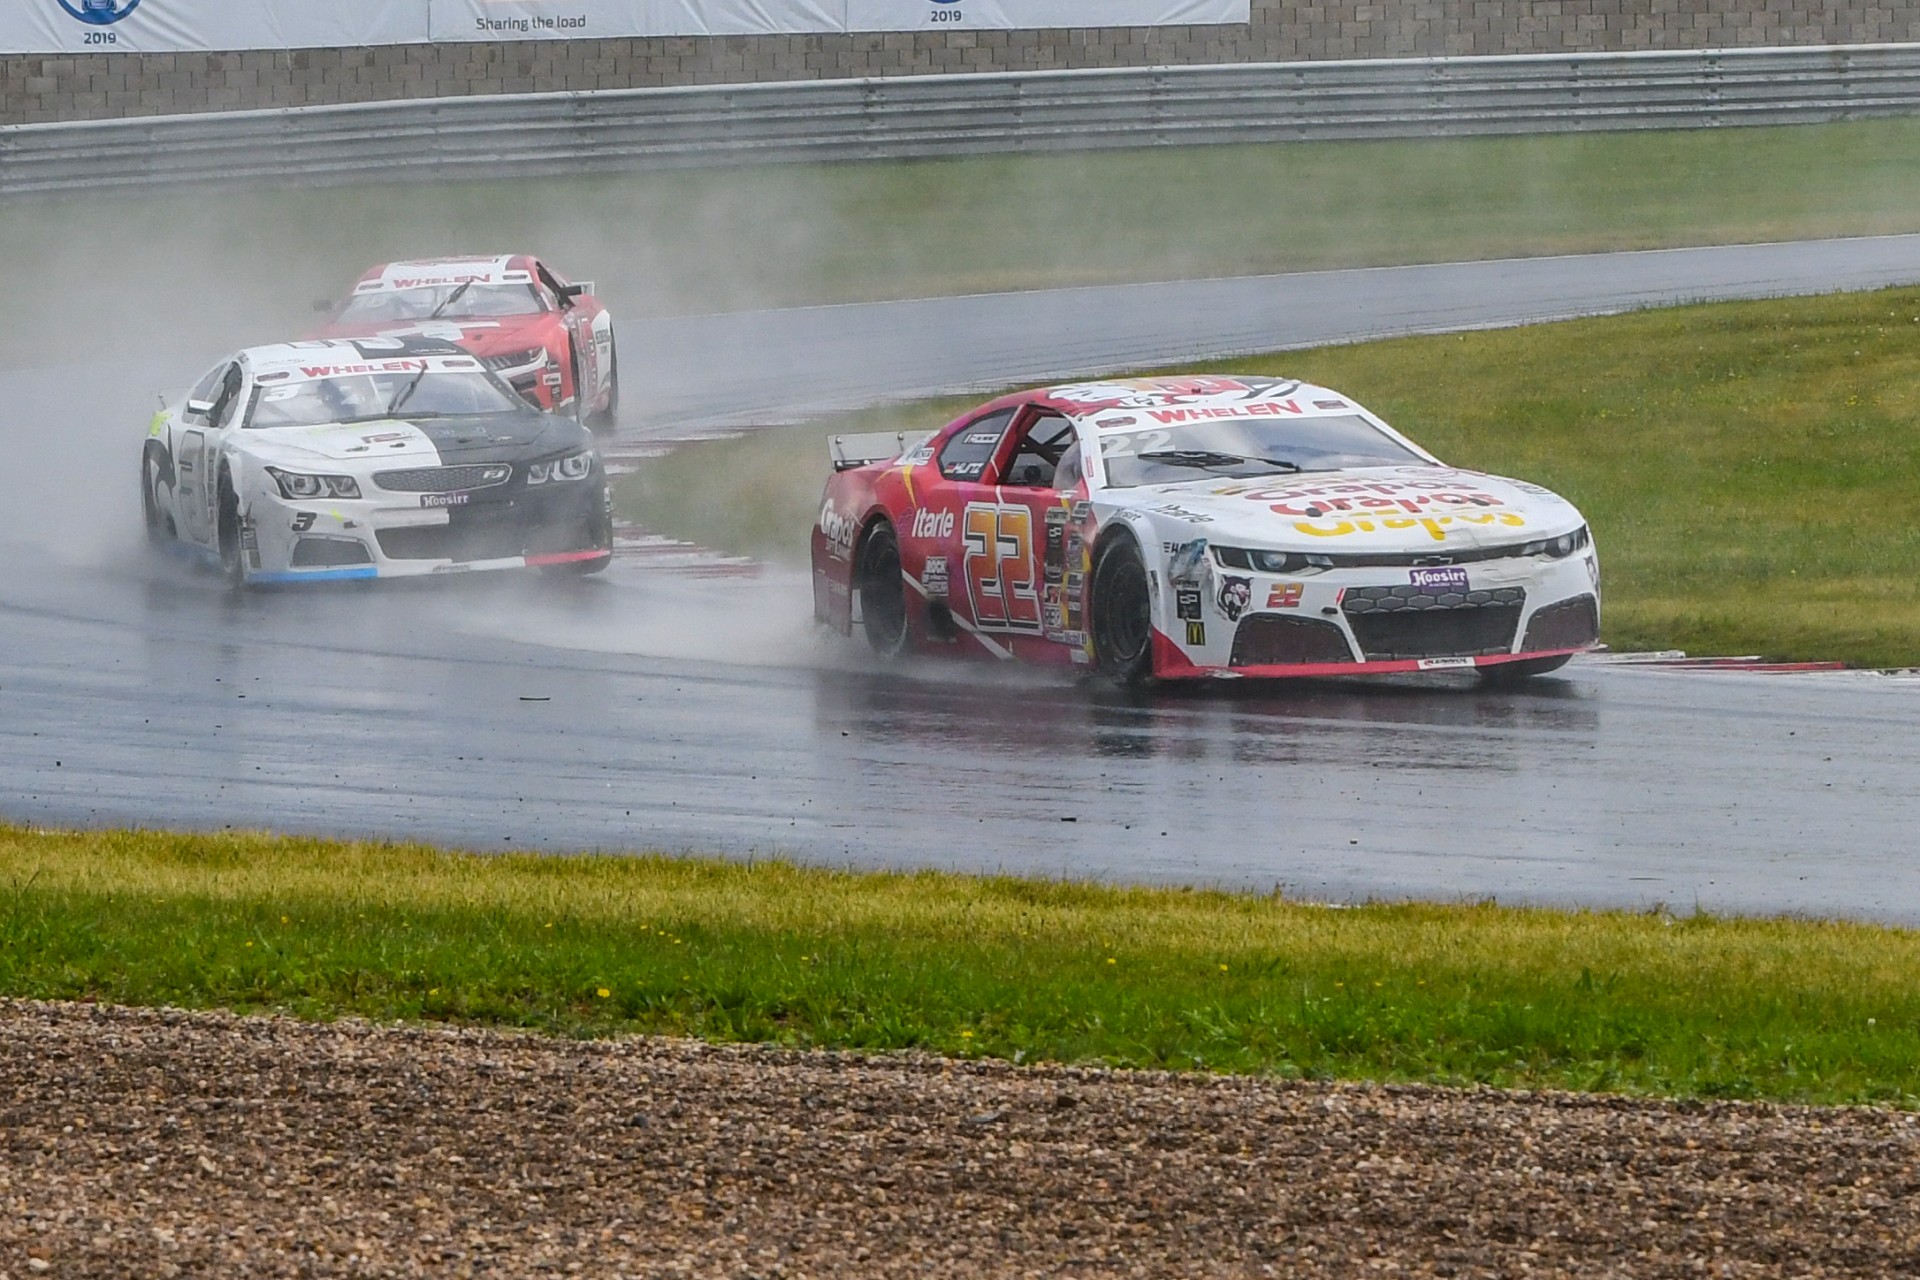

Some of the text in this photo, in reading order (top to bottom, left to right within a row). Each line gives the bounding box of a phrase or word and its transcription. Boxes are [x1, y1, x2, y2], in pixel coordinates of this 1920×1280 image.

[476, 14, 586, 32] Sharing the load
[931, 10, 962, 22] 2019
[83, 32, 117, 44] 2019
[393, 274, 490, 288] WHELEN
[300, 360, 427, 378] WHELEN
[1146, 399, 1304, 424] WHELEN
[1101, 430, 1176, 458] 22
[292, 512, 317, 532] 3
[962, 501, 1043, 636] 22
[1266, 582, 1304, 608] 22
